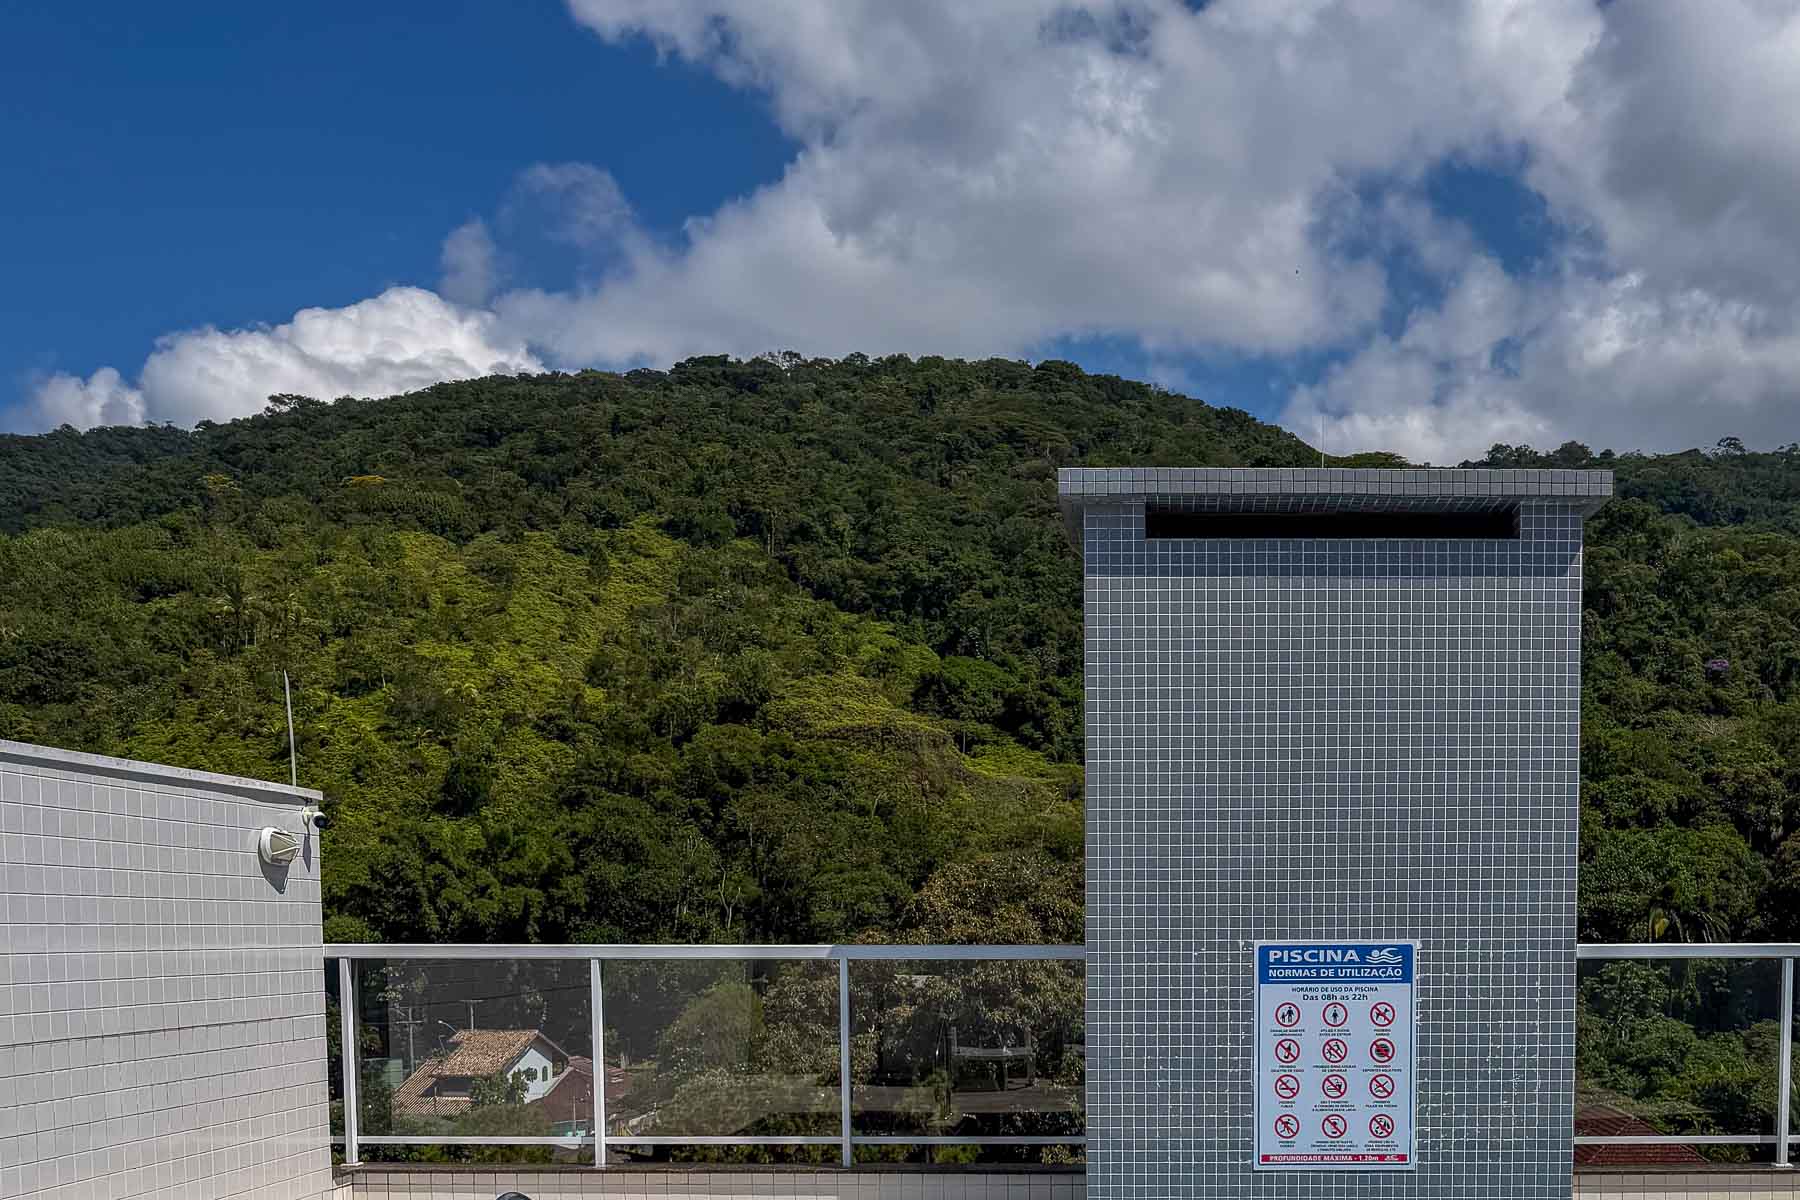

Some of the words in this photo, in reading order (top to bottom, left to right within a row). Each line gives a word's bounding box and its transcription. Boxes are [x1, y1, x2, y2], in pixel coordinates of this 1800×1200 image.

[1269, 950, 1360, 963] PISCINA
[1268, 968, 1317, 977] NORMAS
[1320, 968, 1335, 977] DE
[1338, 967, 1403, 979] UTILIZAÇÃO
[1302, 993, 1319, 1001] Das
[1321, 993, 1338, 1001] 08h
[1351, 993, 1368, 1001] 22h
